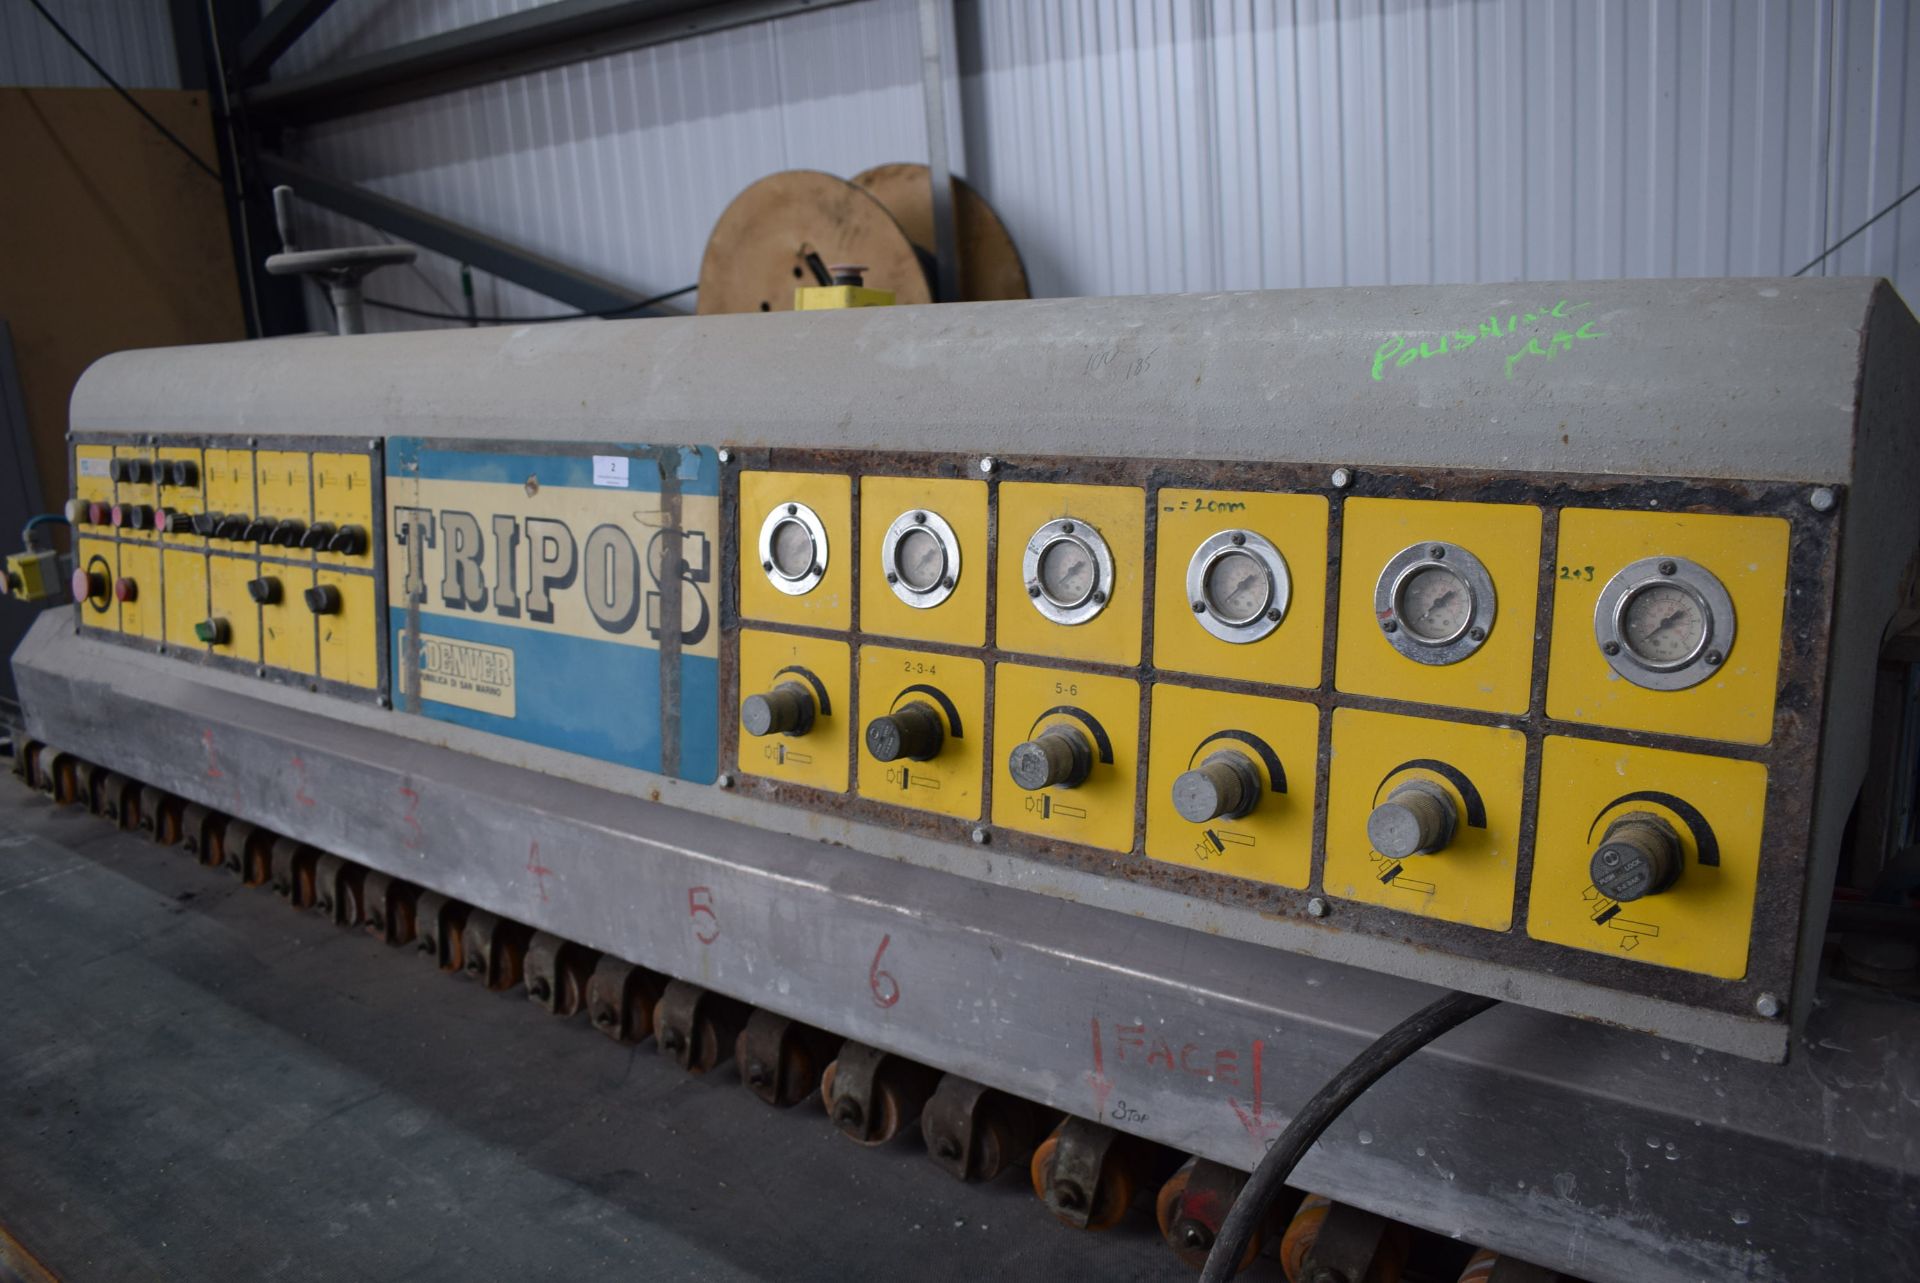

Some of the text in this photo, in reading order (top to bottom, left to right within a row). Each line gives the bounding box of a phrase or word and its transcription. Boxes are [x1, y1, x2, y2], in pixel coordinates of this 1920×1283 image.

[394, 506, 711, 646] TRIPOS
[427, 641, 512, 687] DENVER
[904, 661, 936, 675] 2-3-4
[1056, 682, 1077, 696] 5-6
[400, 787, 423, 849] 3
[526, 839, 554, 904] 4
[688, 886, 720, 945] 5
[870, 933, 900, 1009] 6
[1115, 1023, 1241, 1086] FACE
